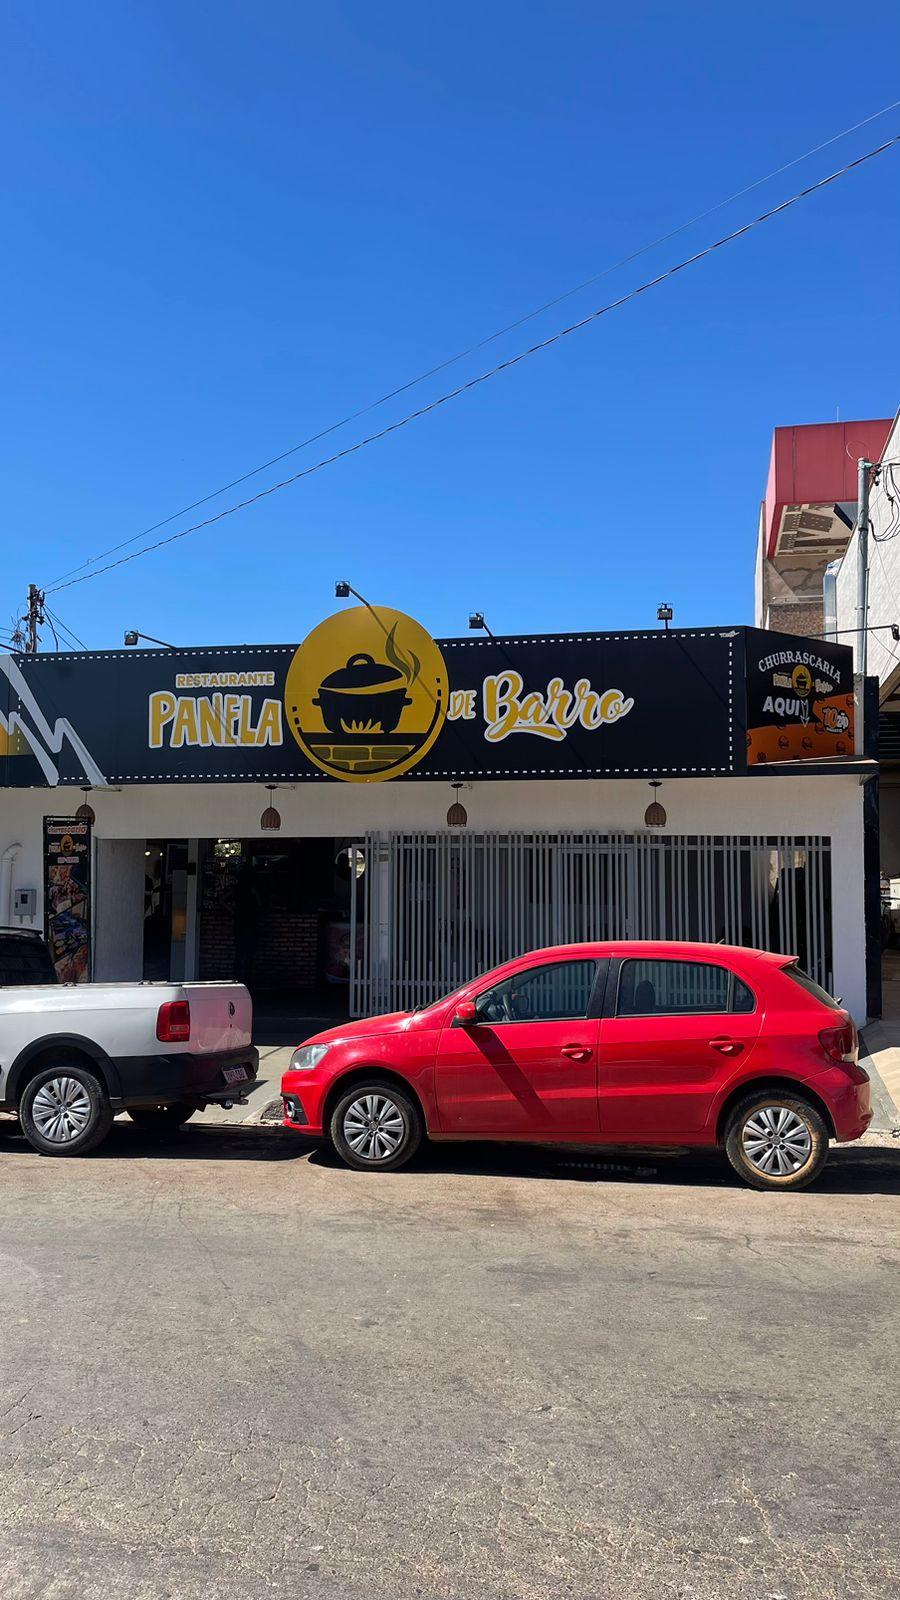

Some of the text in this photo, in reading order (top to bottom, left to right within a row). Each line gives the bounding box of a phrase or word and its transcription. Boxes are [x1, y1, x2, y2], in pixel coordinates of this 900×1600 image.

[175, 671, 275, 688] RESTAURANTE
[758, 651, 841, 684] CHURRASCARIA
[149, 670, 635, 748] PANELA DE Barro
[762, 696, 800, 717] AQUI
